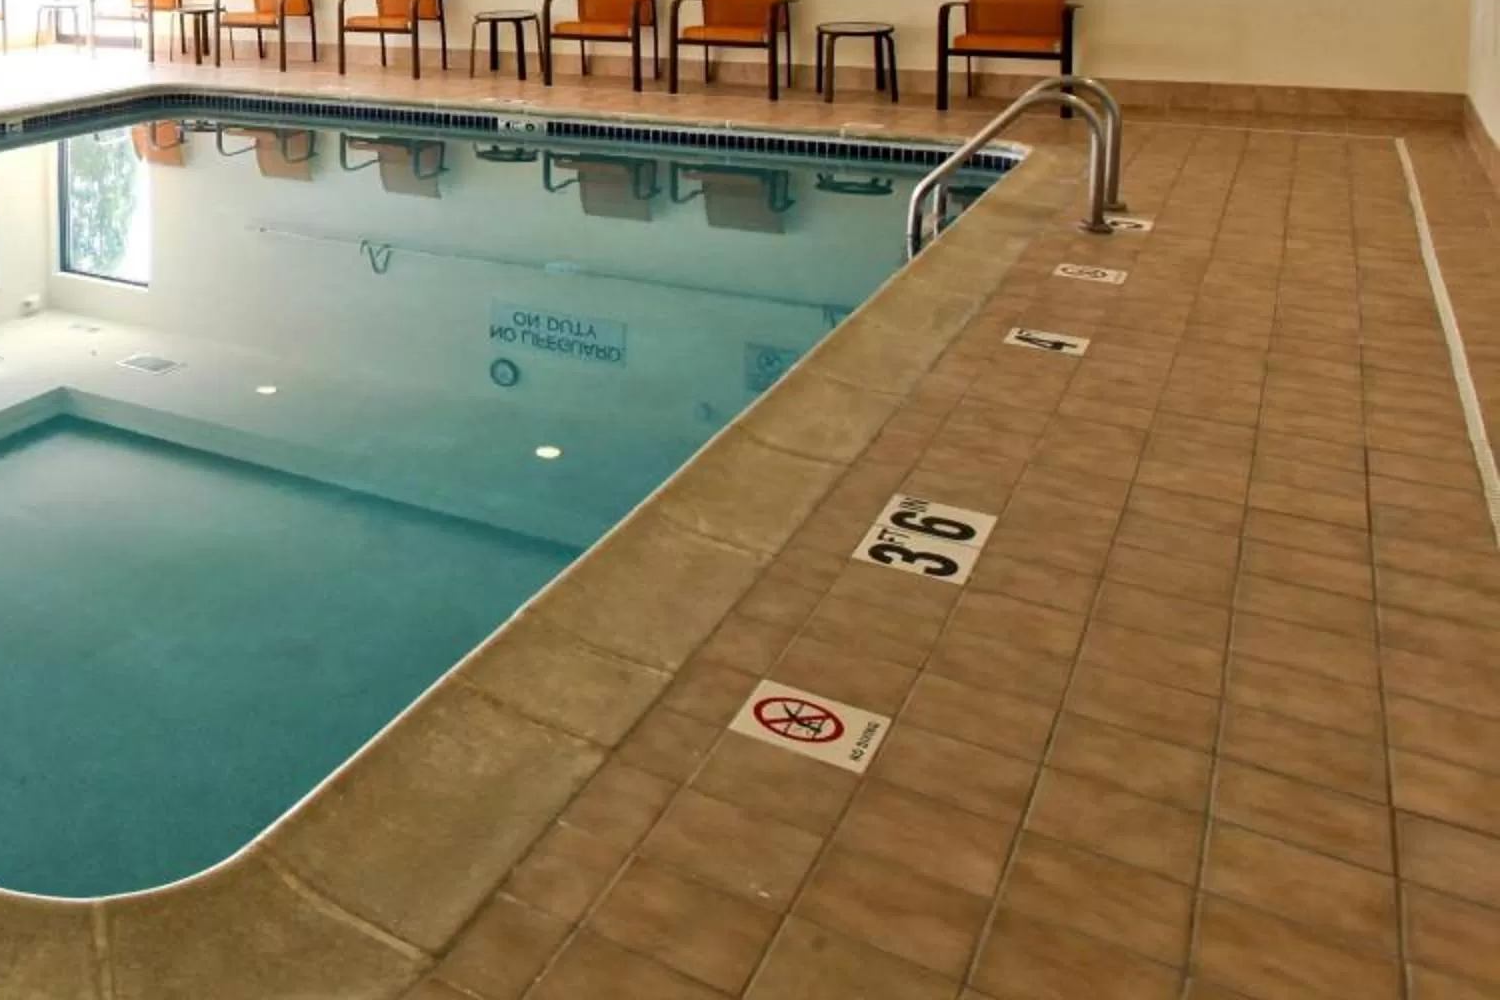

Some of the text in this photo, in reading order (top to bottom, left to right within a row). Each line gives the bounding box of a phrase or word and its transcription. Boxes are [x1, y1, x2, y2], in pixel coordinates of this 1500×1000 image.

[1015, 335, 1078, 351] 4
[890, 510, 977, 541] 6
[868, 543, 959, 577] 3
